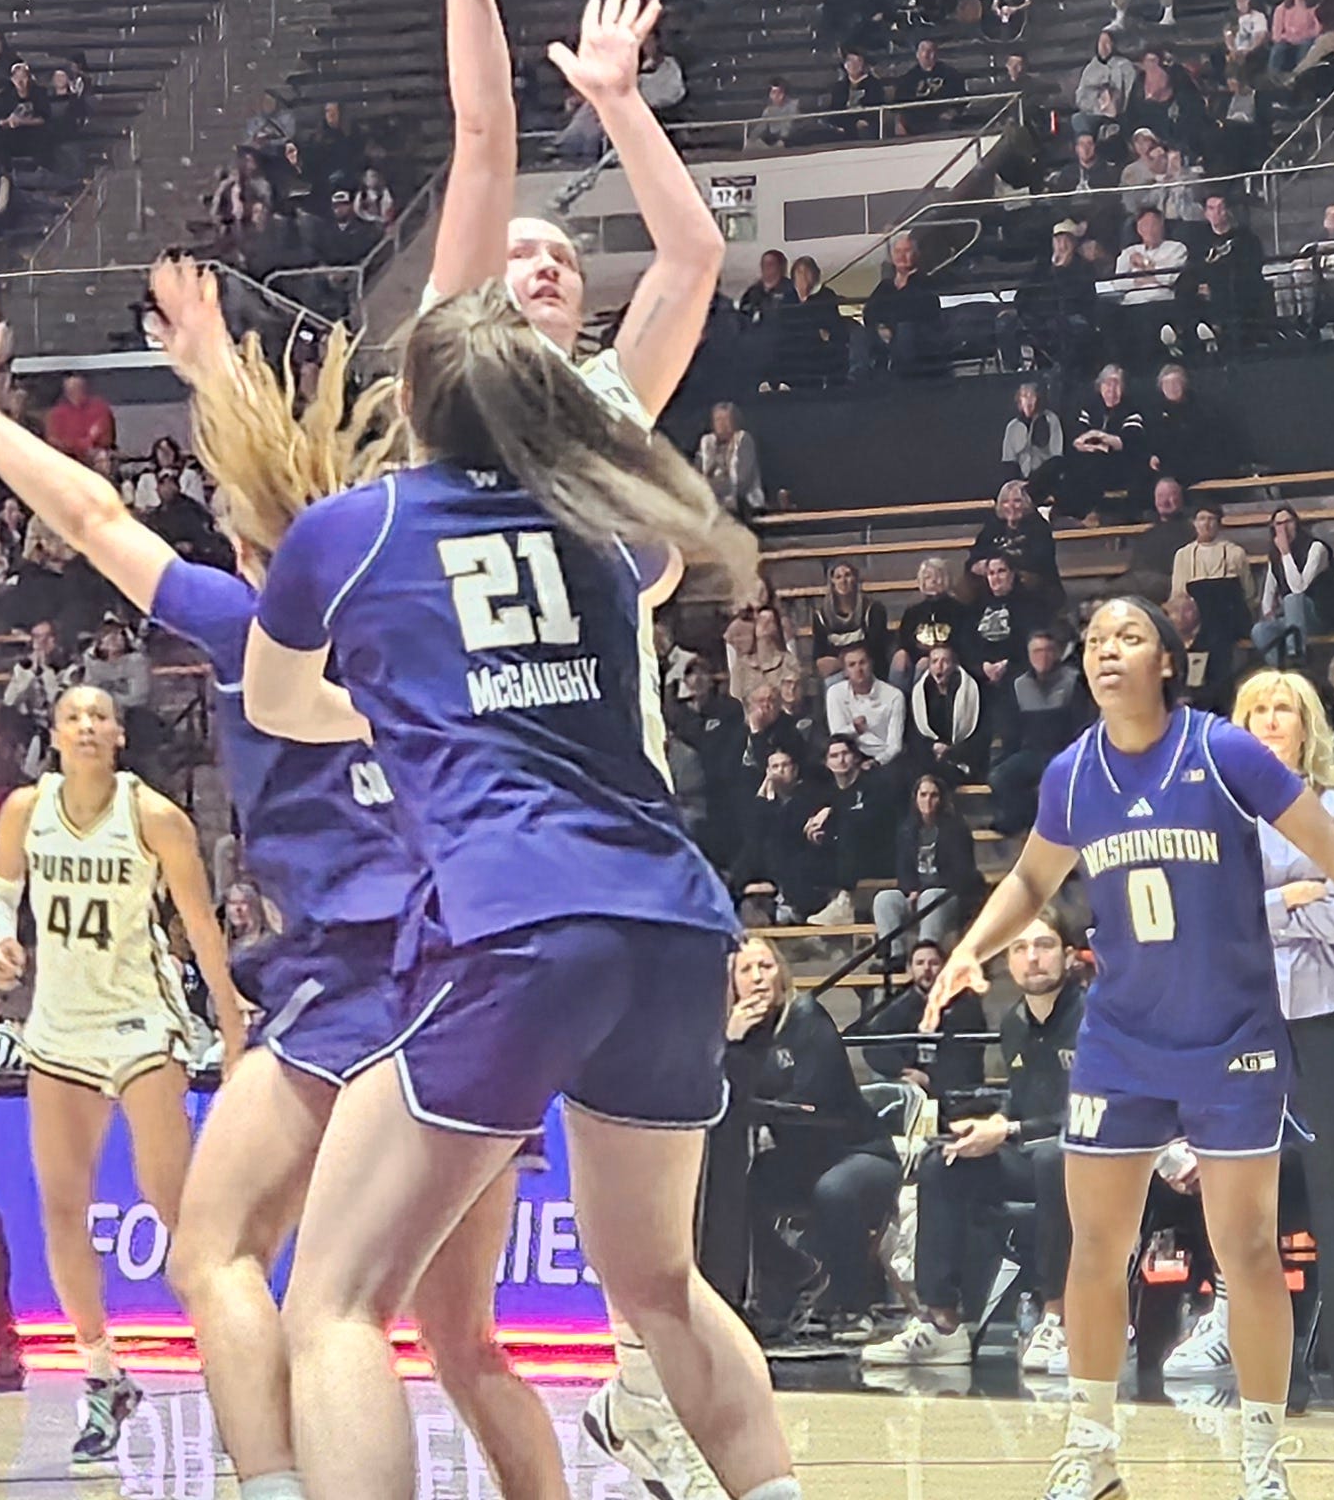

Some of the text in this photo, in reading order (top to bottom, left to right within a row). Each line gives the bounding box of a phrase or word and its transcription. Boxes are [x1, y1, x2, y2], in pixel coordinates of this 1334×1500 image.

[437, 531, 581, 652] 21
[466, 657, 601, 715] McGAUGHY
[1081, 827, 1220, 878] WASHINGTON
[47, 895, 112, 952] 44
[1126, 867, 1176, 943] 0
[1069, 1092, 1108, 1139] W
